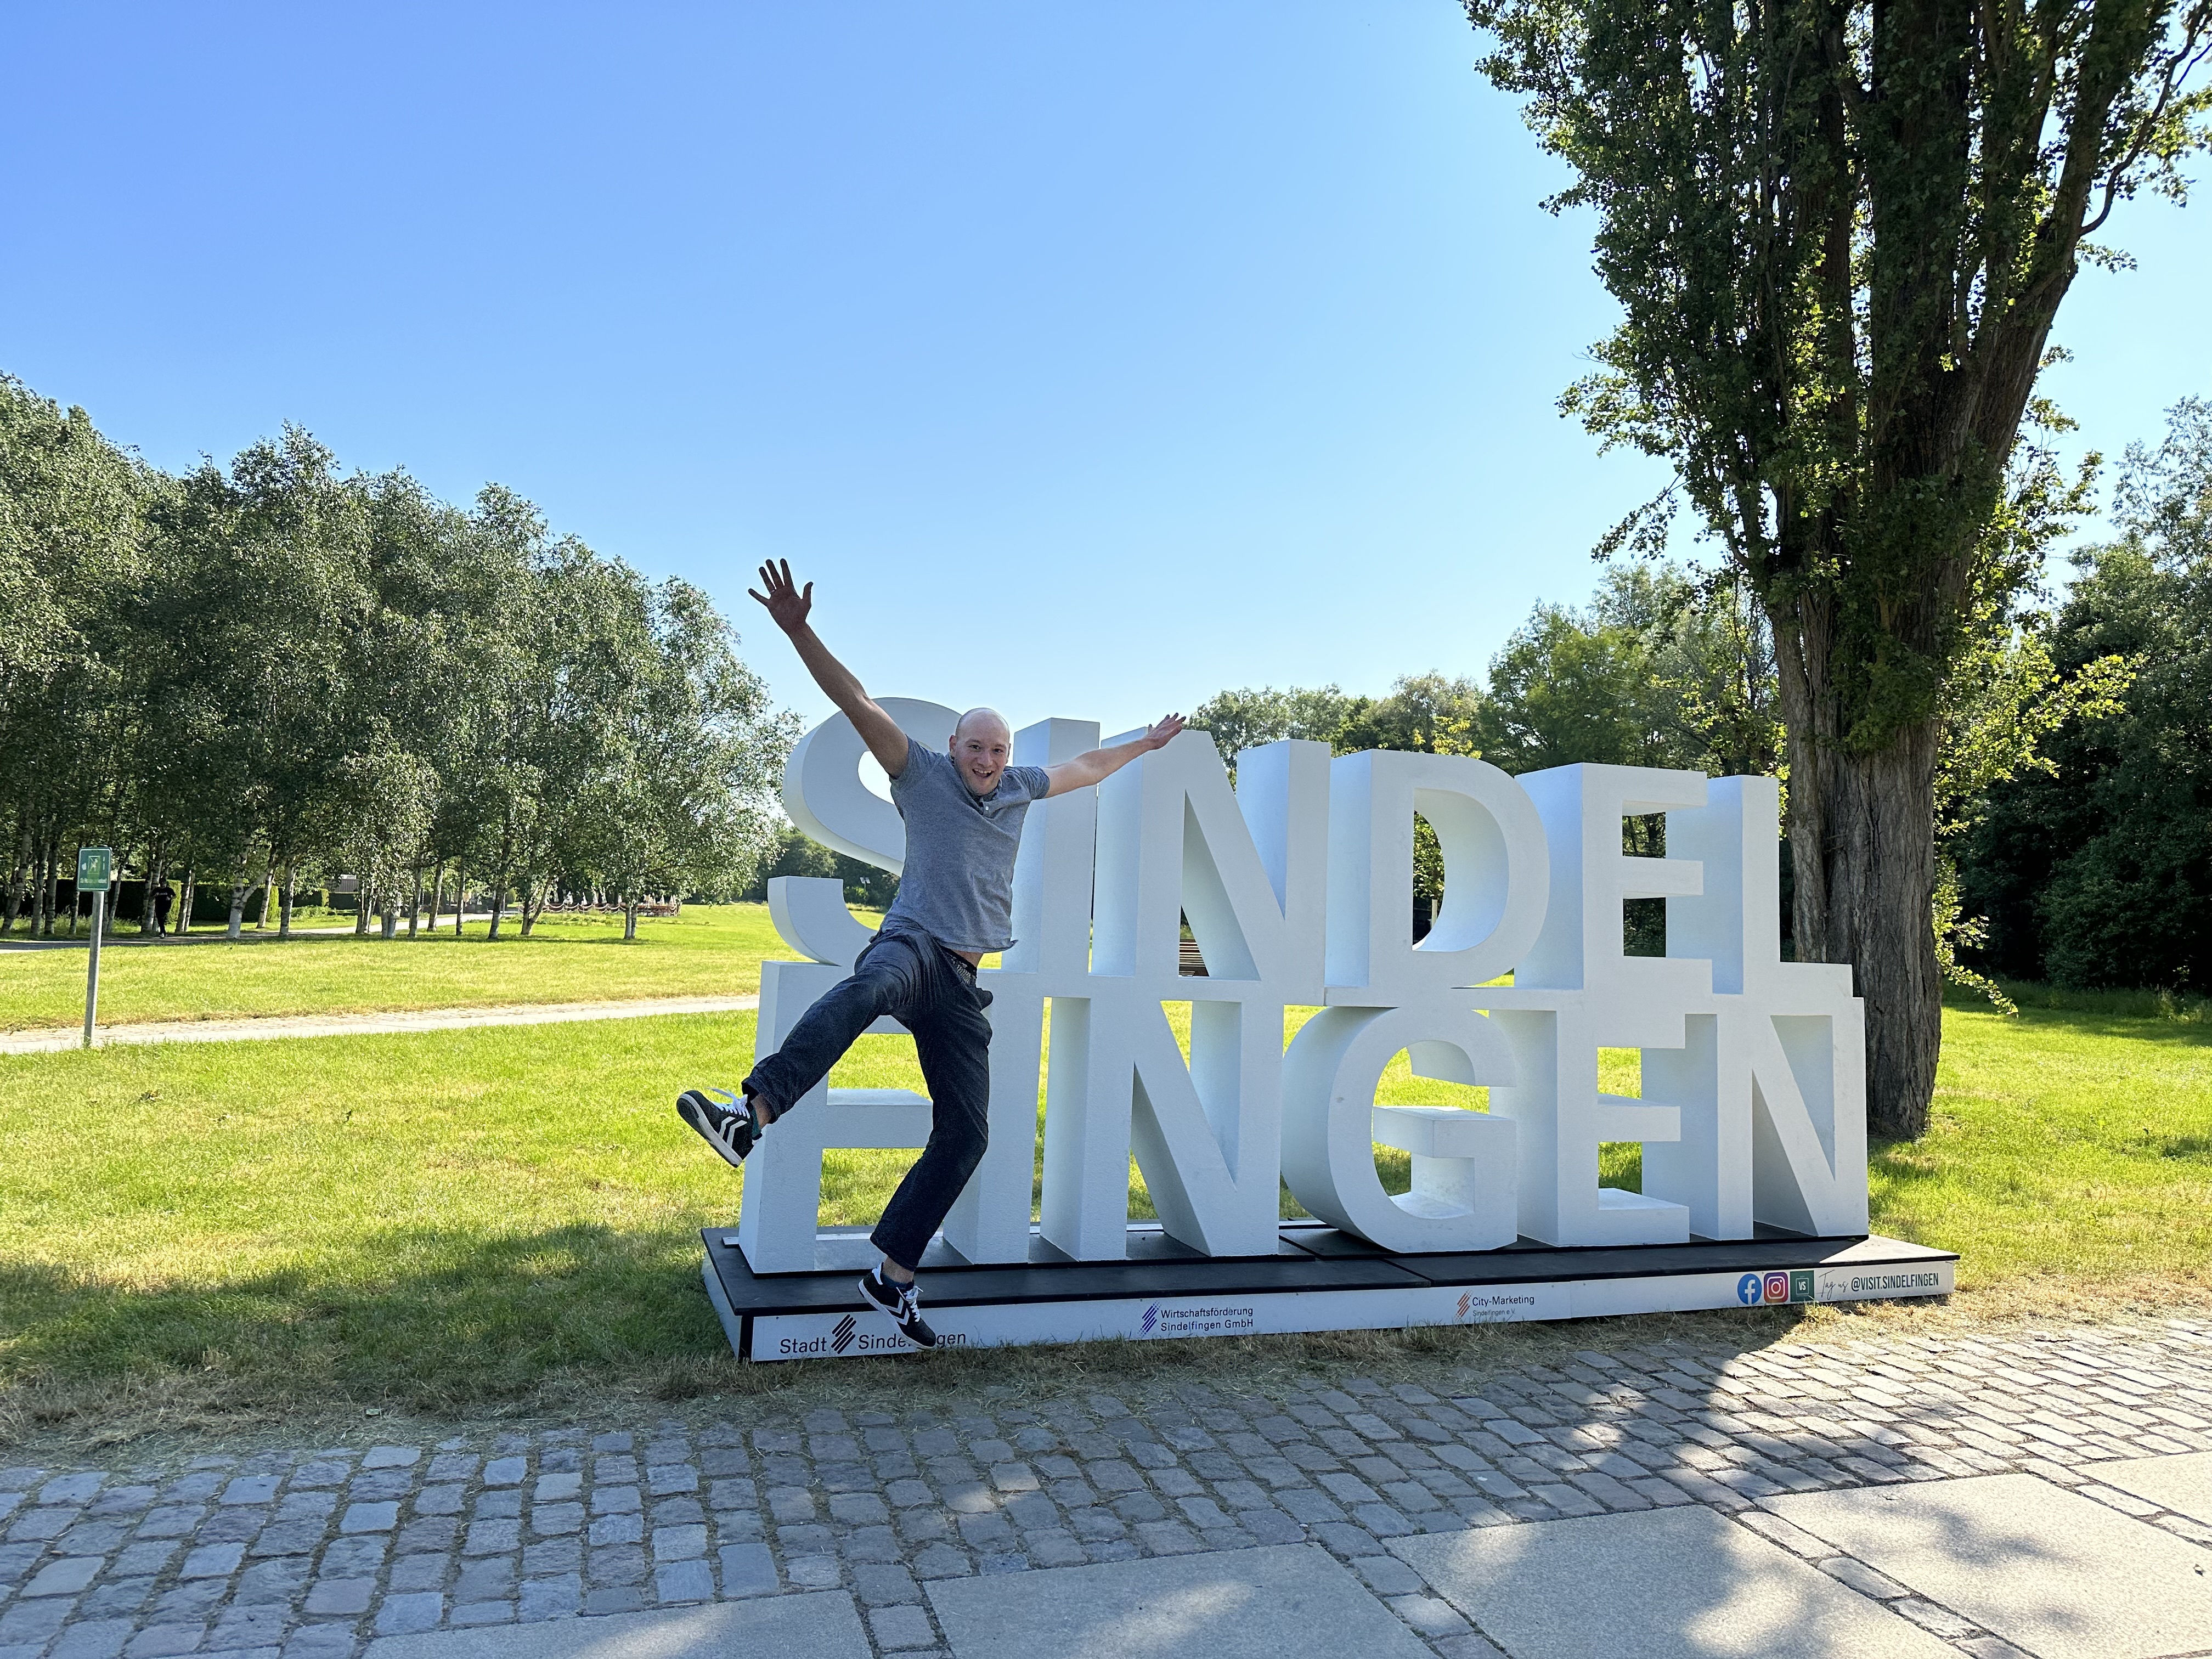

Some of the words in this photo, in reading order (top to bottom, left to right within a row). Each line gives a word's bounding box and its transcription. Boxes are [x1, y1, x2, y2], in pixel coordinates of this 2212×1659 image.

[739, 963, 1869, 1273] FINGEN
[1798, 1281, 1806, 1291] VS
[1819, 1269, 1836, 1300] Tag
[1851, 1273, 1939, 1292] @VISIT.SINDELFINGEN
[1472, 1295, 1534, 1307] City-Marketing
[1161, 1307, 1253, 1318] Wirtschaftsförderung
[1161, 1321, 1221, 1331] Sindelfingen
[1224, 1319, 1253, 1328] GmbH
[780, 1337, 827, 1354] Stadt
[858, 1333, 966, 1350] Sindegen
